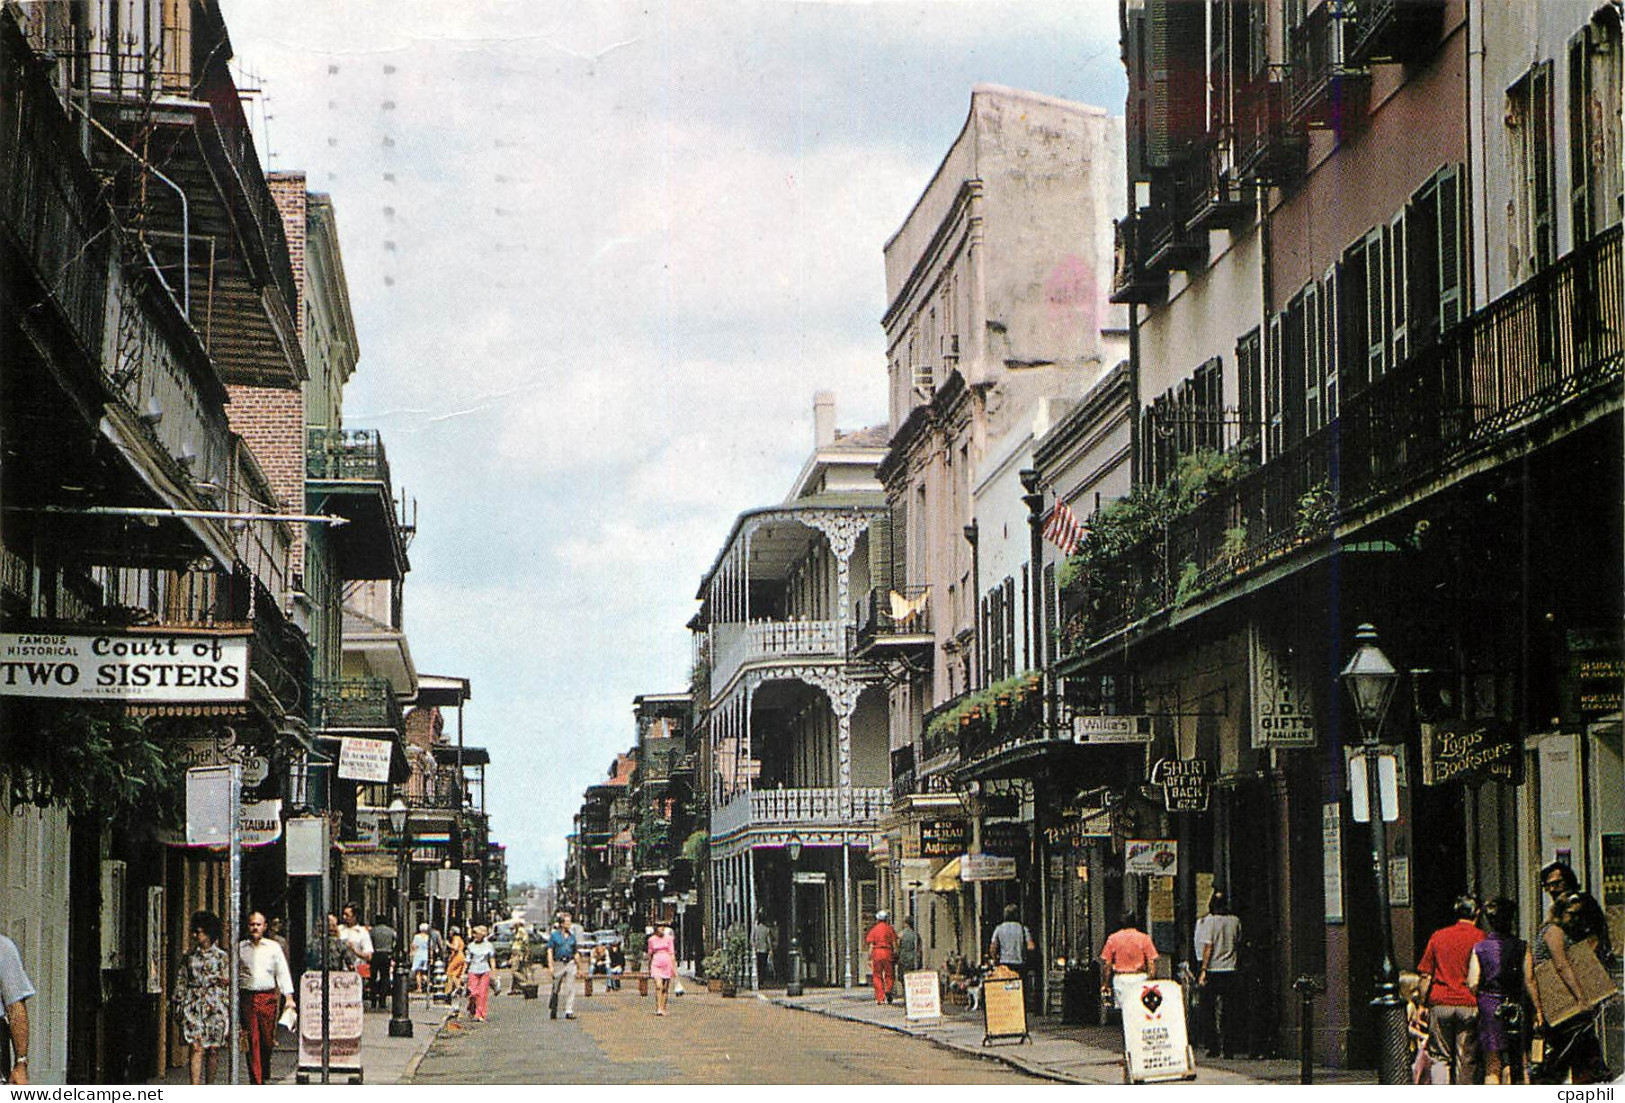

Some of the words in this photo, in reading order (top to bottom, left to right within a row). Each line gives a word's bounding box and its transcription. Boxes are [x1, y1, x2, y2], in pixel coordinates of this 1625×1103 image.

[18, 636, 67, 645] FAMOUS
[7, 647, 79, 656] HISTORICAL
[91, 636, 179, 656] Court
[192, 637, 222, 662] of
[0, 662, 80, 686] TWO
[96, 664, 239, 687] SISTERS
[1434, 743, 1512, 780] Bookstore
[1162, 761, 1207, 776] SHIRT
[1166, 776, 1185, 786] OFF
[1190, 776, 1203, 786] MY
[1172, 787, 1203, 798] BACK
